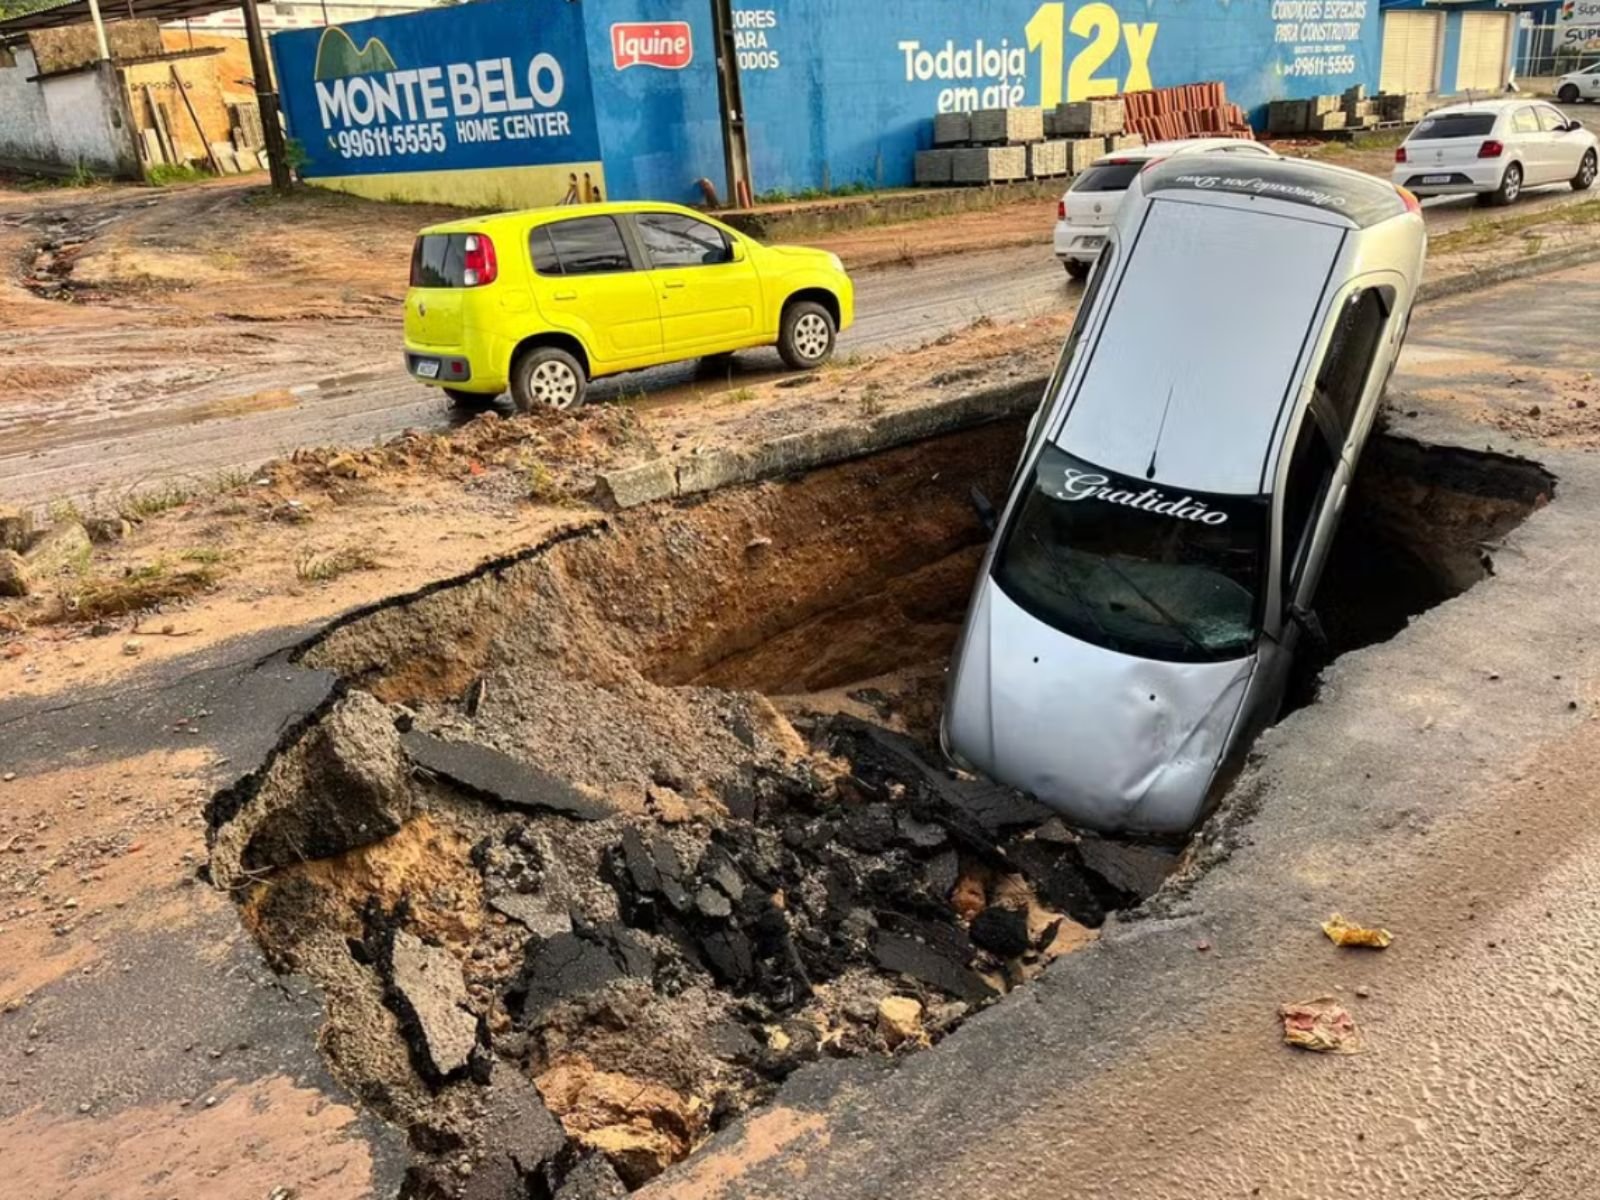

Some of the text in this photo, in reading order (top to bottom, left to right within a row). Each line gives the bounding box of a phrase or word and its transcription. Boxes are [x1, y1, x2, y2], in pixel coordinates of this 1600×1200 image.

[732, 10, 777, 28] ORES
[1275, 22, 1361, 42] PARA CONSTRUTOR
[618, 29, 687, 63] Iquine
[734, 30, 768, 49] ARA
[736, 50, 780, 69] ODOS
[898, 38, 1026, 81] Toda loja
[315, 52, 564, 129] MONTE BELO
[937, 78, 1025, 113] em até
[455, 111, 571, 143] HOME CENTER
[1056, 468, 1228, 525] Gratidão
